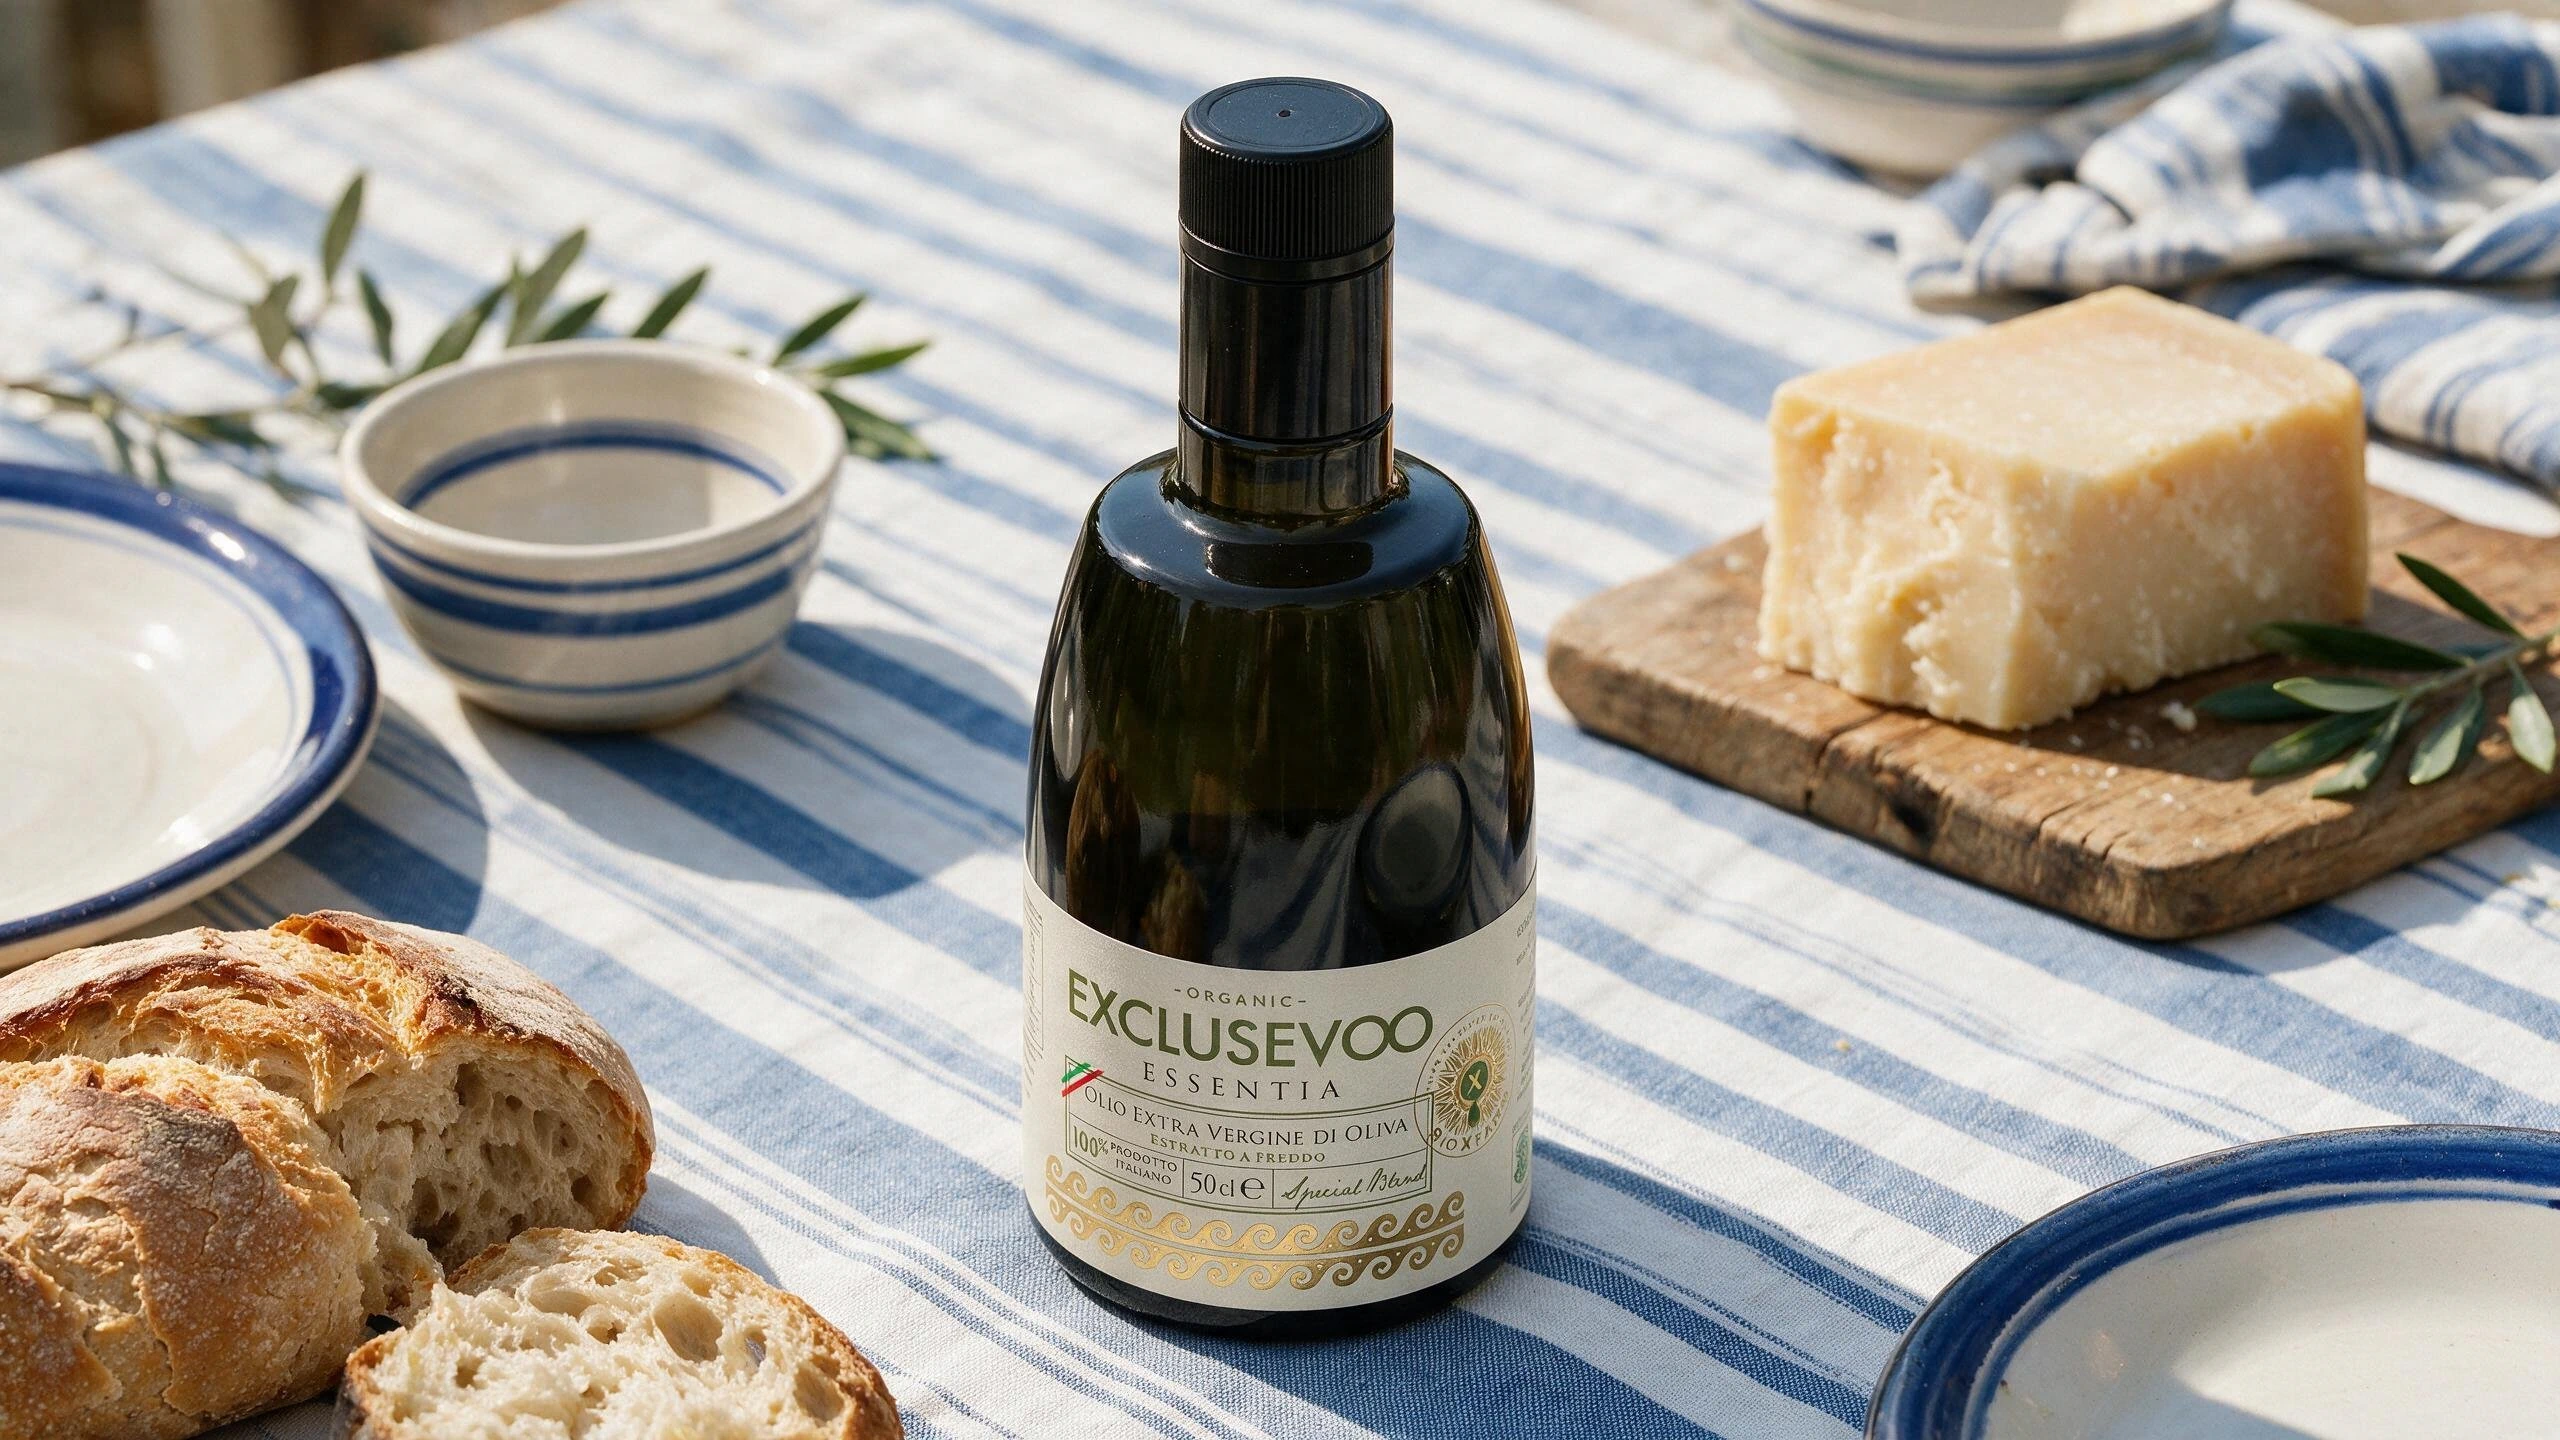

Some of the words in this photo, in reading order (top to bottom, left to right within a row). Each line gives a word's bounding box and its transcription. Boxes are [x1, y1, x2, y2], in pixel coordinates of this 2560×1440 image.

[1069, 968, 1434, 1067] EXCLUSEVOO
[1144, 1062, 1339, 1100] ESSENTIA
[1085, 1086, 1126, 1116] OLIO
[1133, 1106, 1199, 1137] EXTRA
[1208, 1123, 1303, 1146] VERGINE
[1314, 1129, 1335, 1144] DI
[1345, 1119, 1408, 1142] OLIVA
[1073, 1125, 1109, 1158] 100%
[1110, 1142, 1177, 1172] PRODOTTO
[1150, 1133, 1235, 1160] ESTRATTO
[1240, 1153, 1250, 1163] A
[1256, 1152, 1325, 1163] FREDDO
[1116, 1159, 1172, 1185] ITALIANO
[1281, 1176, 1362, 1210] Special
